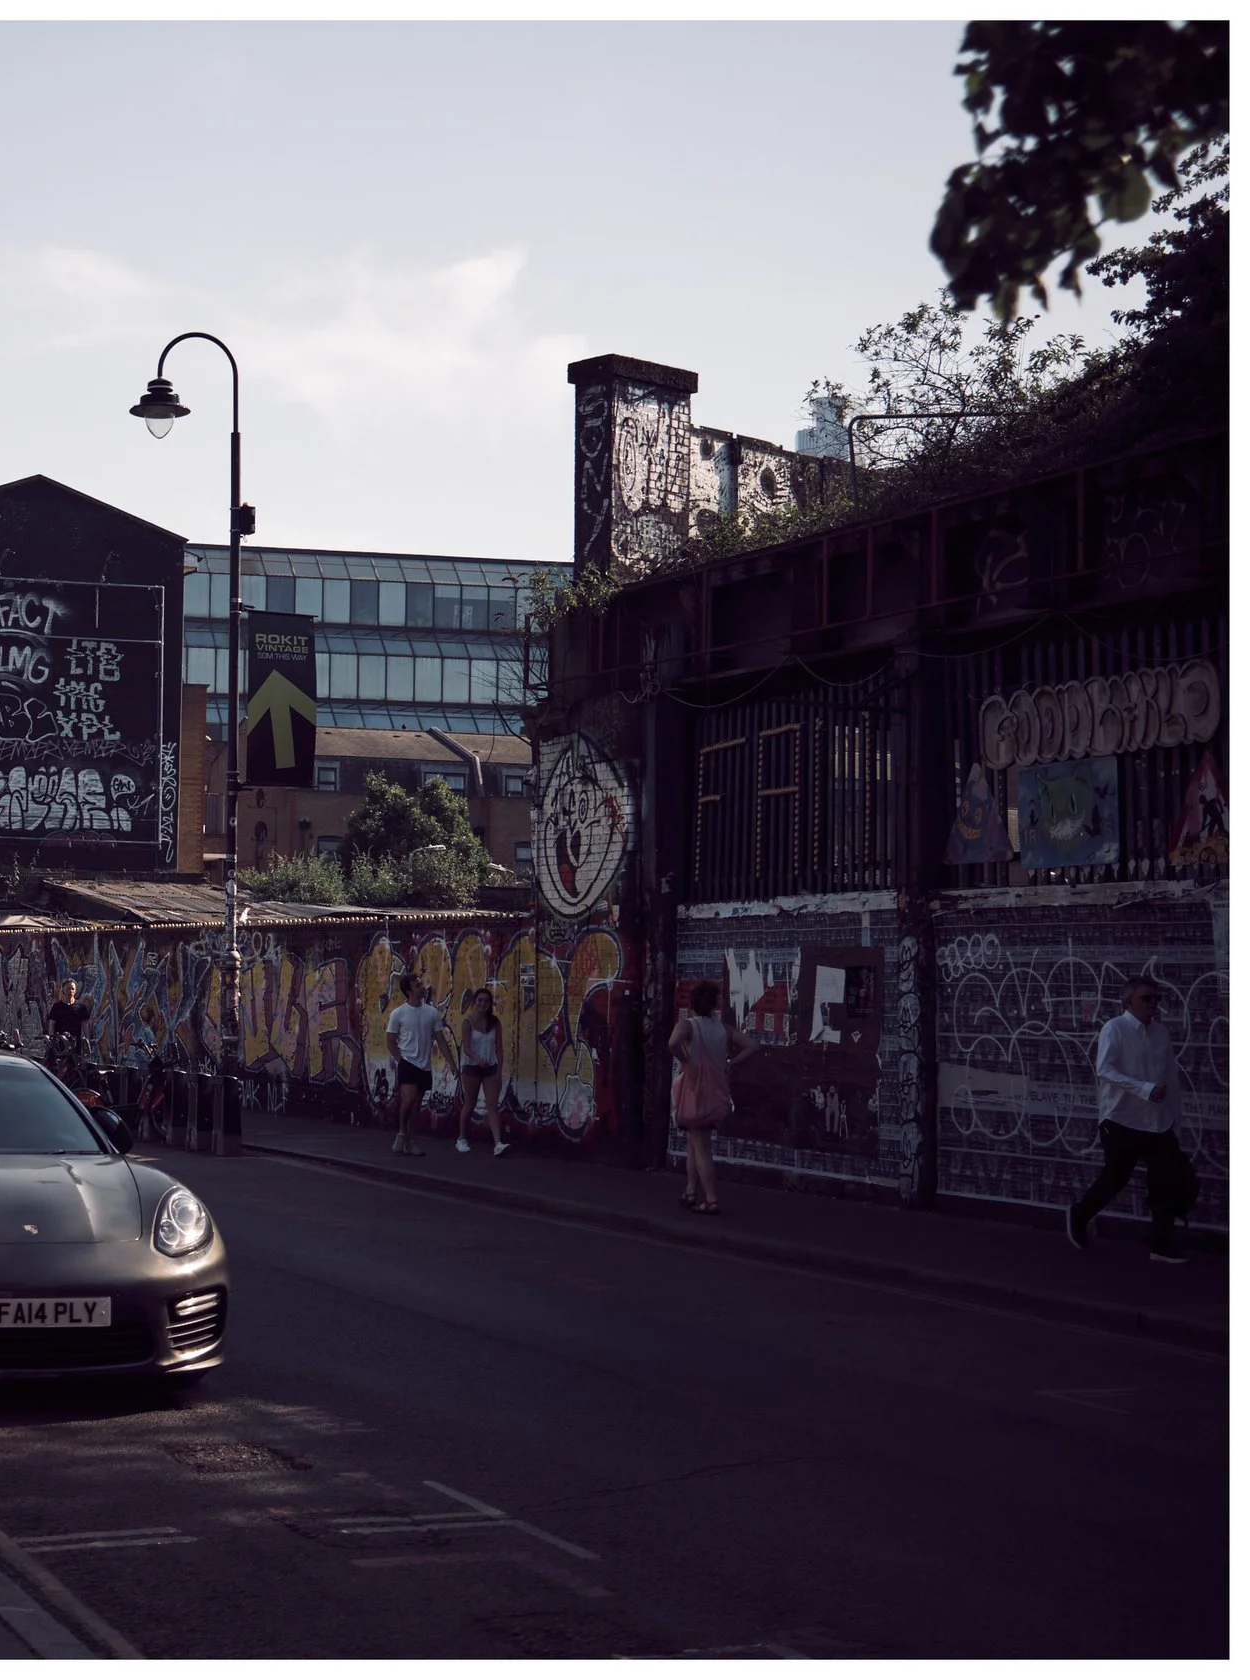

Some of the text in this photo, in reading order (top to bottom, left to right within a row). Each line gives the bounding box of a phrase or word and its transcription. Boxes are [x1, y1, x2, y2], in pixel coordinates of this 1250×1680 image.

[255, 633, 308, 646] ROKIT
[255, 643, 309, 654] VINTAGE
[274, 652, 291, 661] THIS
[291, 654, 308, 662] WAY
[1030, 1090, 1059, 1103] SLAVE
[1063, 1091, 1076, 1104] TO
[1080, 1092, 1098, 1105] THE
[53, 1301, 98, 1323] PLY
